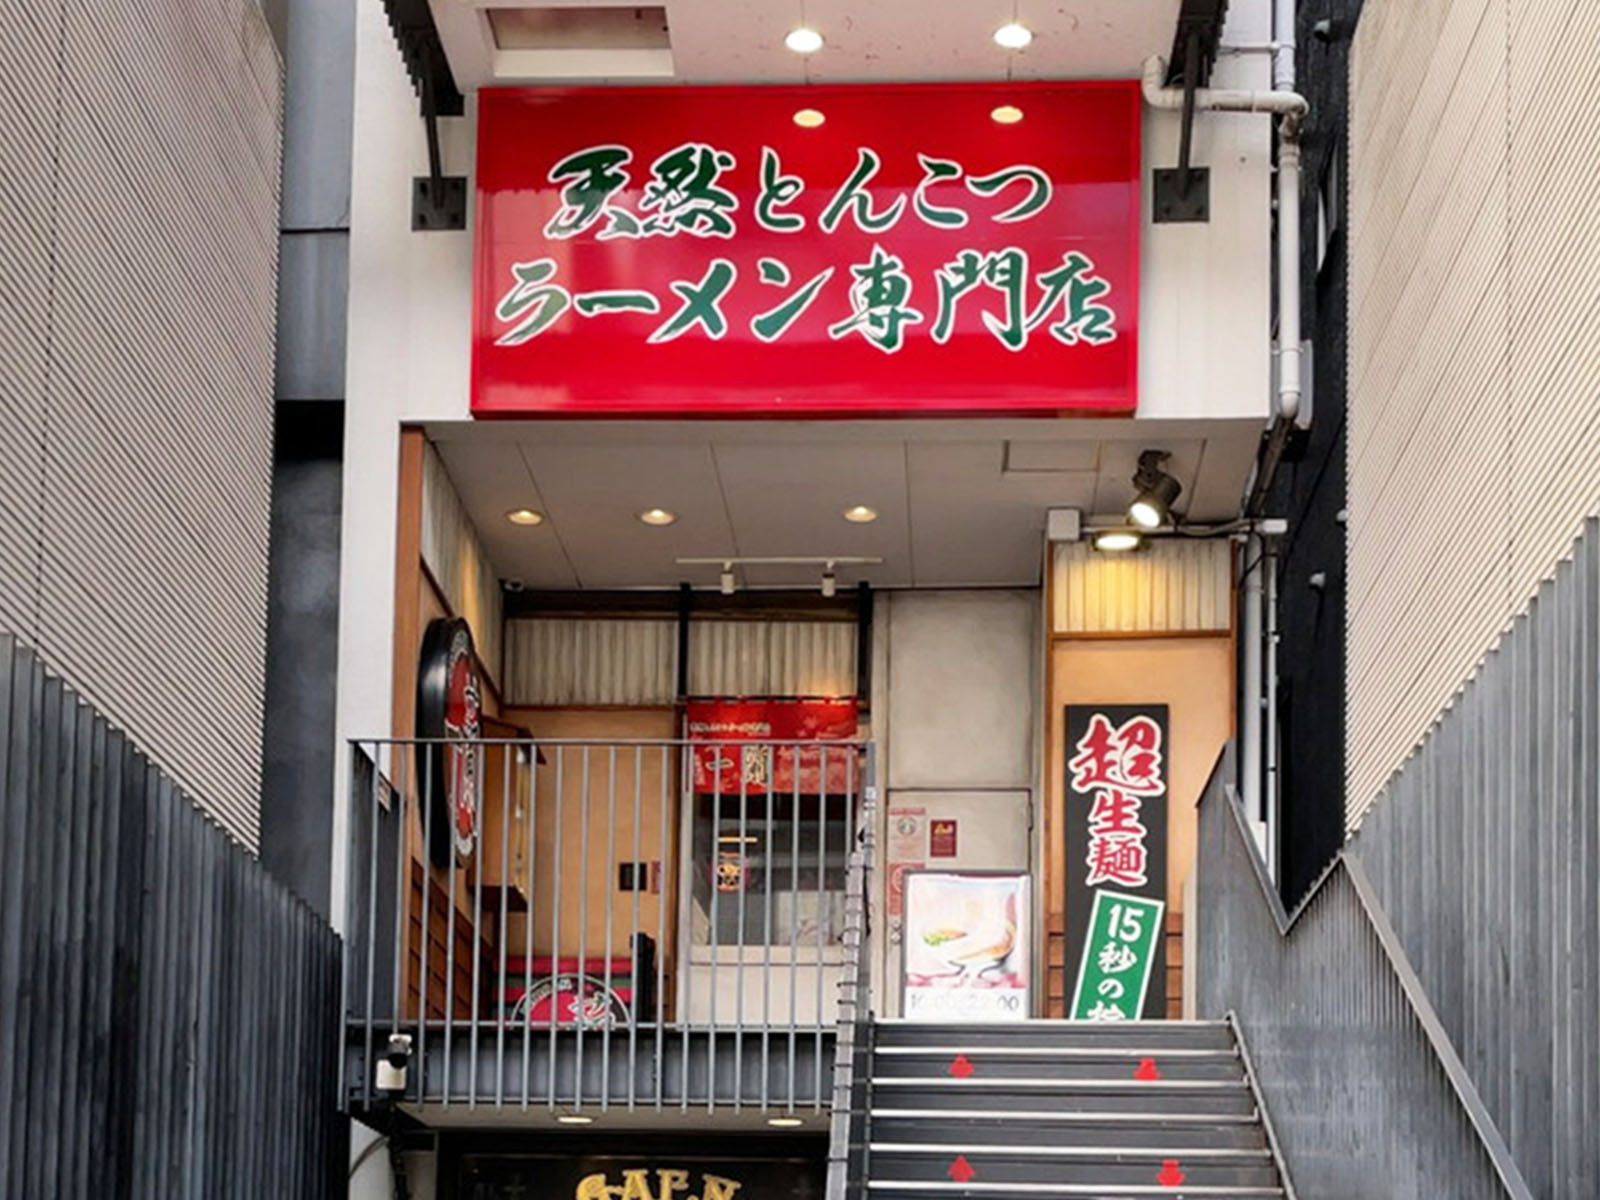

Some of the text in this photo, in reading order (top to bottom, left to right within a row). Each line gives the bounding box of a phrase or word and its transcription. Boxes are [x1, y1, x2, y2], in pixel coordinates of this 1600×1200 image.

[544, 142, 1052, 240] 天然とんこつ
[494, 245, 1117, 354] ラーメン専門店
[1068, 713, 1166, 886] 超生麺
